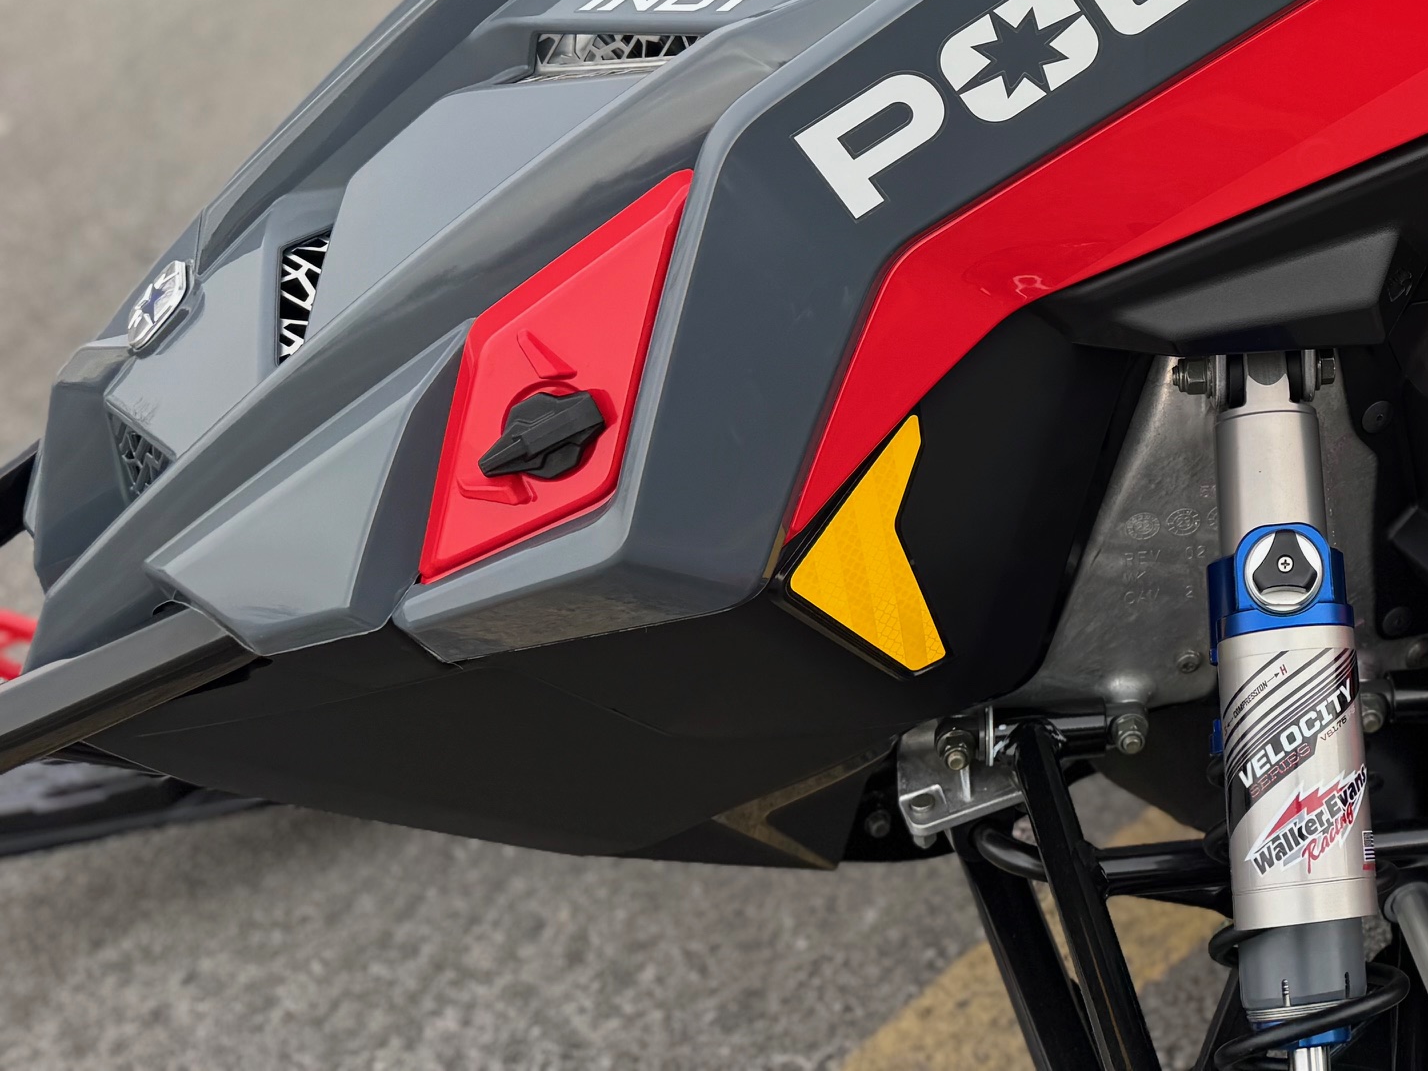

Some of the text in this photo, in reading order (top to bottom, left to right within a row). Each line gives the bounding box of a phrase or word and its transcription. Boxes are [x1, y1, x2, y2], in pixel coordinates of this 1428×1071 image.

[1232, 680, 1269, 719] COMPRESSION
[1238, 678, 1351, 789] VELOCITY
[1249, 743, 1312, 799] SERIES
[1323, 767, 1366, 821] Evans
